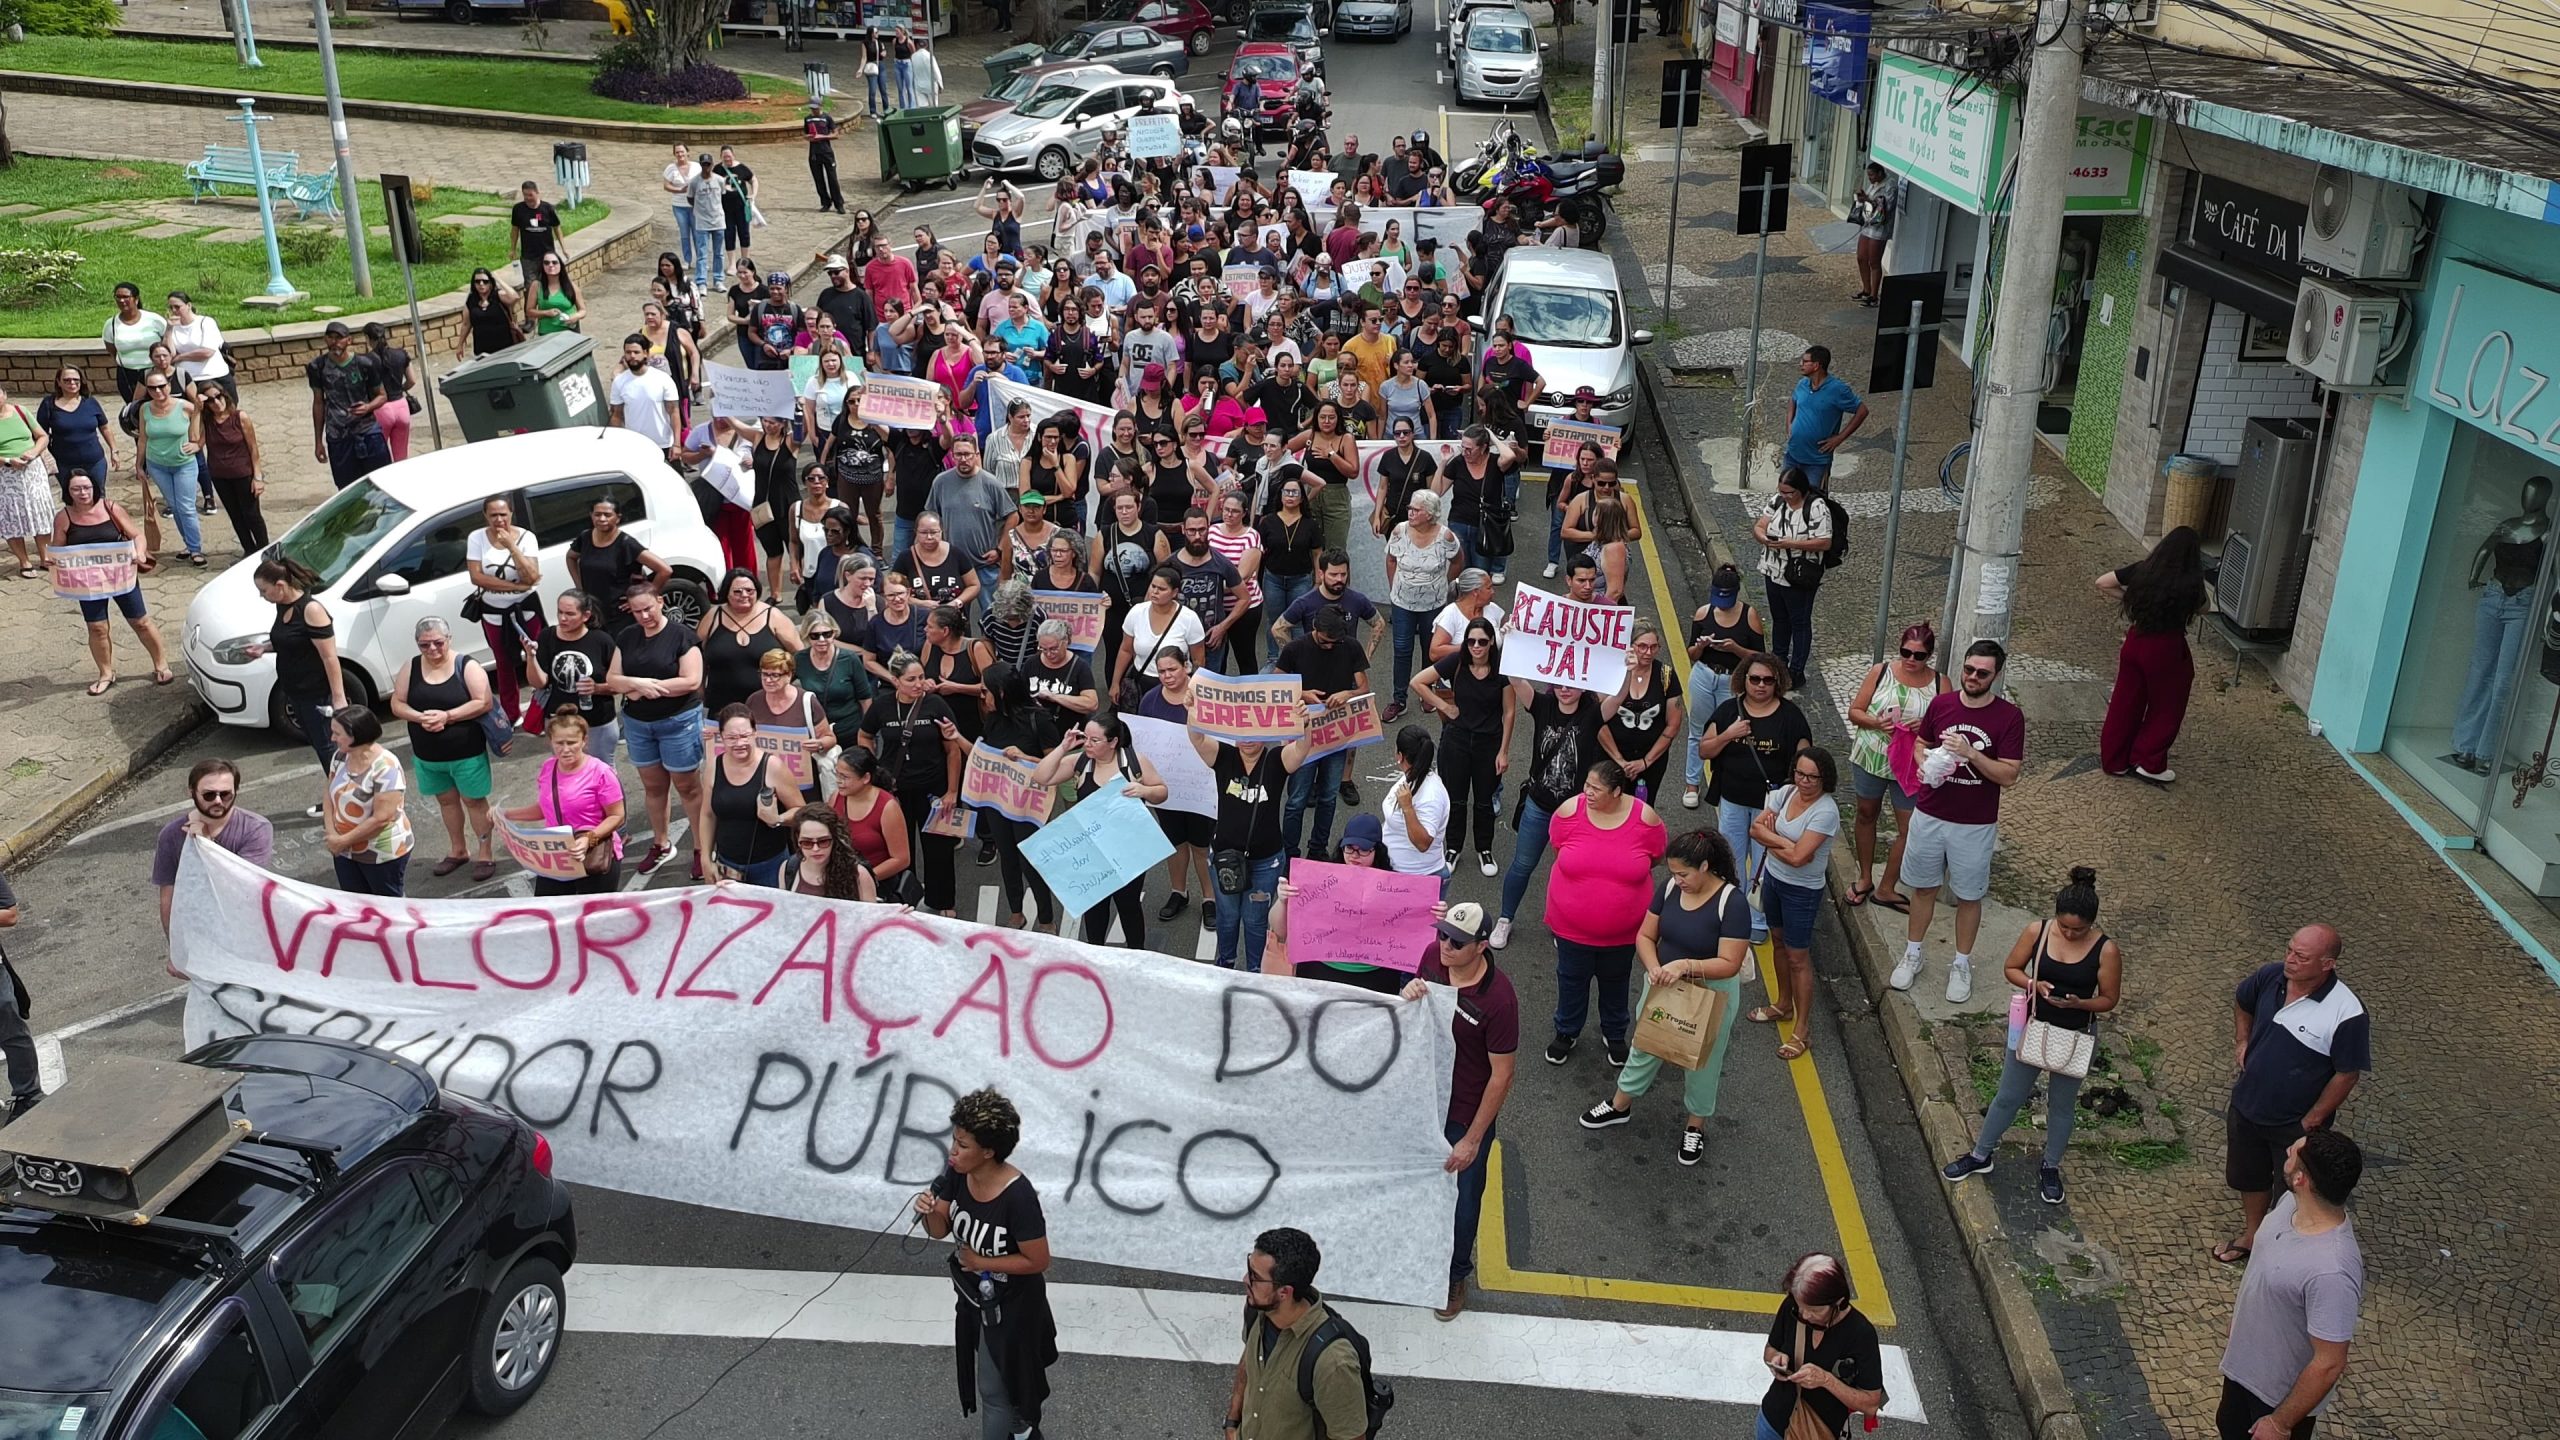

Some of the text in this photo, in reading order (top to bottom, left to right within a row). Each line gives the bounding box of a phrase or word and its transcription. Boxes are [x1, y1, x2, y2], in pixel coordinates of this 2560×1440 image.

[1885, 76, 1944, 137] Tic Tac
[1908, 137, 1936, 162] Modas
[2075, 139, 2131, 148] Modas
[2266, 224, 2287, 261] DA
[2331, 329, 2340, 343] LG
[868, 384, 932, 400] ESTAMOS EM
[865, 394, 932, 421] GREVE
[1552, 428, 1614, 444] ESTAMOS EM
[57, 554, 112, 568] STAMOS
[57, 564, 134, 588] GREVE
[1083, 603, 1098, 614] EM
[1511, 590, 1632, 650] REAJUSTE
[1536, 640, 1590, 681] JÁ!
[1196, 684, 1293, 703] ESTAMOS EM
[1197, 700, 1295, 728] GREVE
[1351, 699, 1369, 713] EM
[1311, 712, 1374, 747] REVE
[783, 740, 801, 752] EM
[972, 752, 1026, 784] ESTAMOS
[968, 768, 1047, 814] GREVE
[951, 808, 965, 827] EM
[544, 841, 567, 851] EM
[262, 880, 1400, 1093] VALORIZAÇÃO DO
[1665, 1012, 1698, 1031] Tropical
